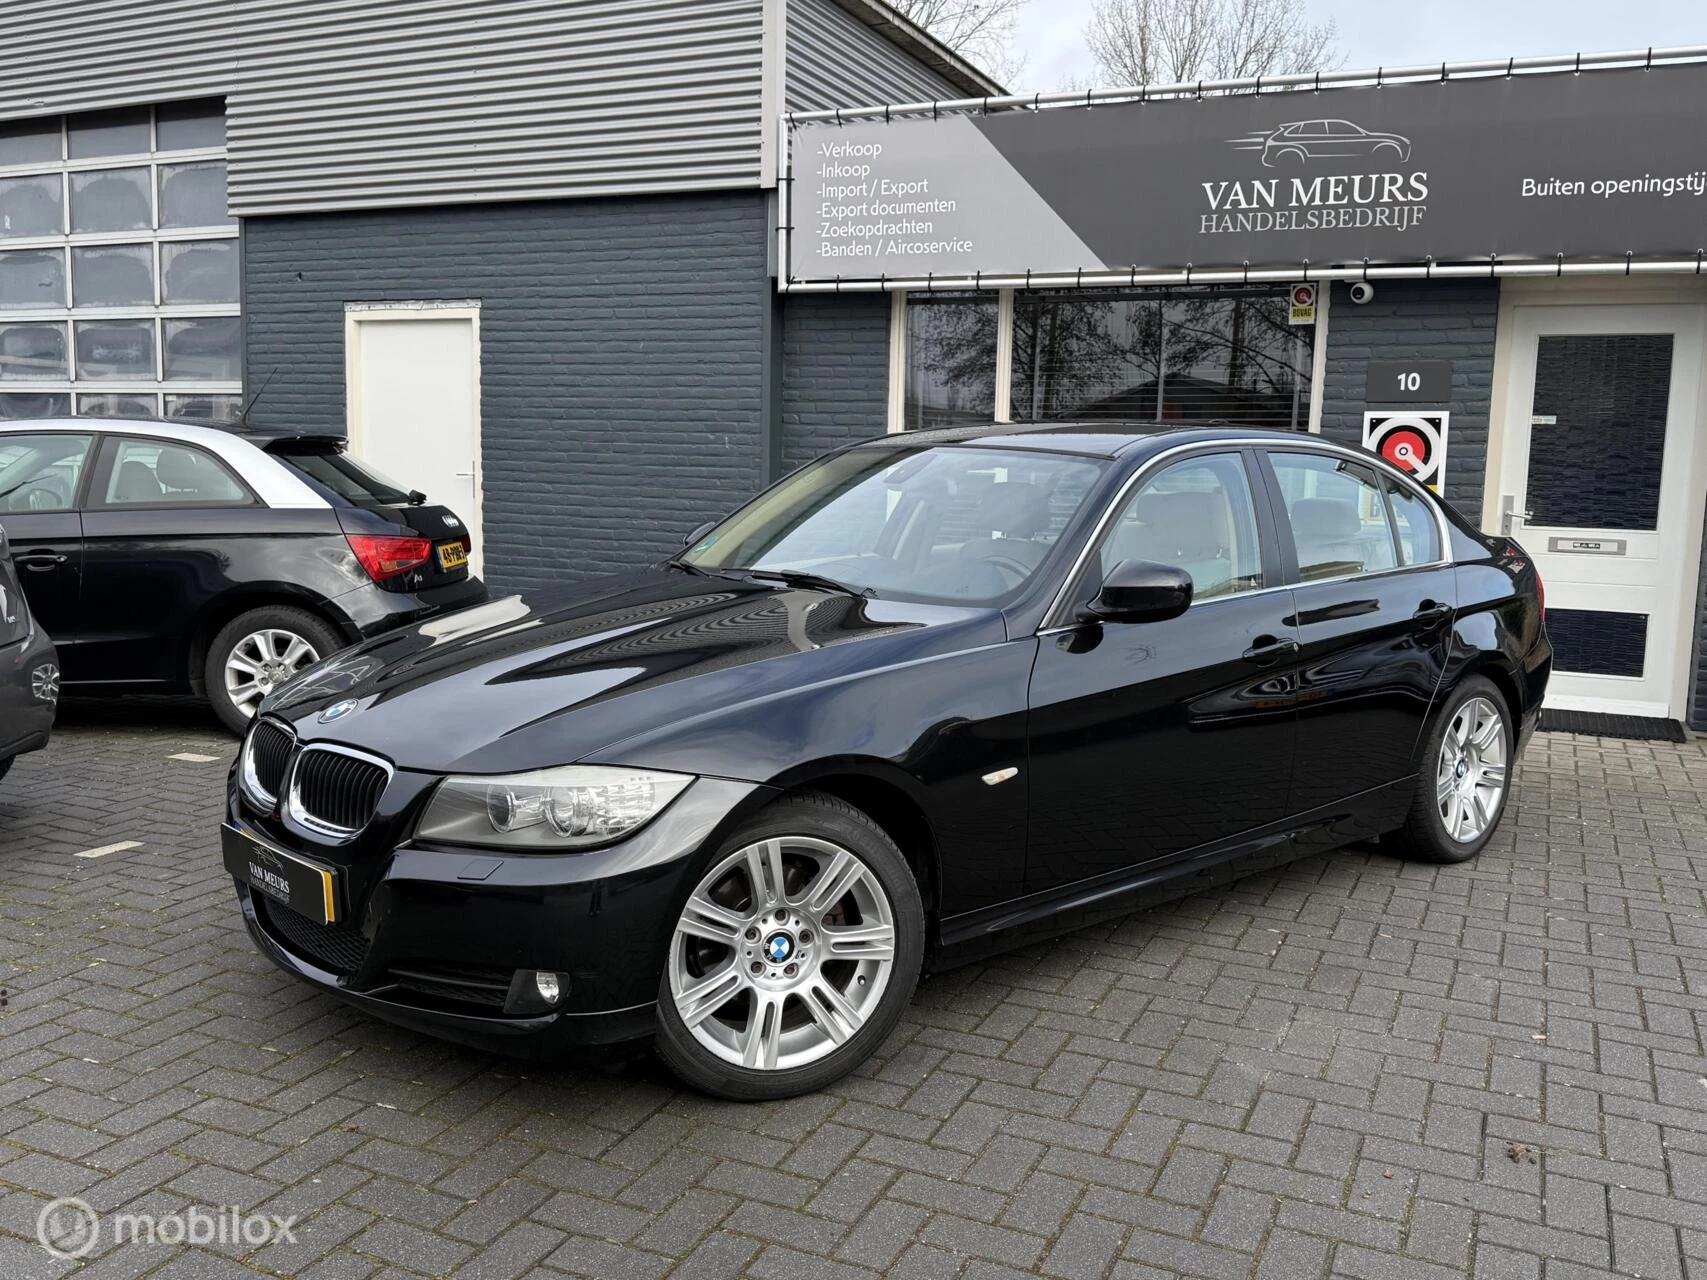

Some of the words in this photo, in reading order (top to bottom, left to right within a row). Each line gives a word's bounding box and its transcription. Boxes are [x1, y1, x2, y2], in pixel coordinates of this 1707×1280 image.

[816, 140, 882, 159] -Verkoop
[816, 161, 871, 180] -Inkoop
[816, 182, 868, 201] -Import
[869, 179, 878, 198] /
[881, 178, 929, 198] Export
[1201, 179, 1280, 210] VAN
[1288, 171, 1429, 207] MEURS
[1521, 177, 1586, 197] Buiten
[1590, 171, 1707, 199] openingstij
[816, 202, 868, 221] -Export
[870, 198, 956, 216] documenten
[1199, 205, 1427, 234] HANDELSBEDRIJF
[816, 218, 933, 240] -Zoekopdrachten
[816, 240, 872, 257] -Banden
[874, 239, 883, 257] /
[885, 237, 973, 255] Aircoservice
[1397, 372, 1421, 391] 10
[249, 861, 264, 880] VAN
[264, 869, 290, 894] MEURS
